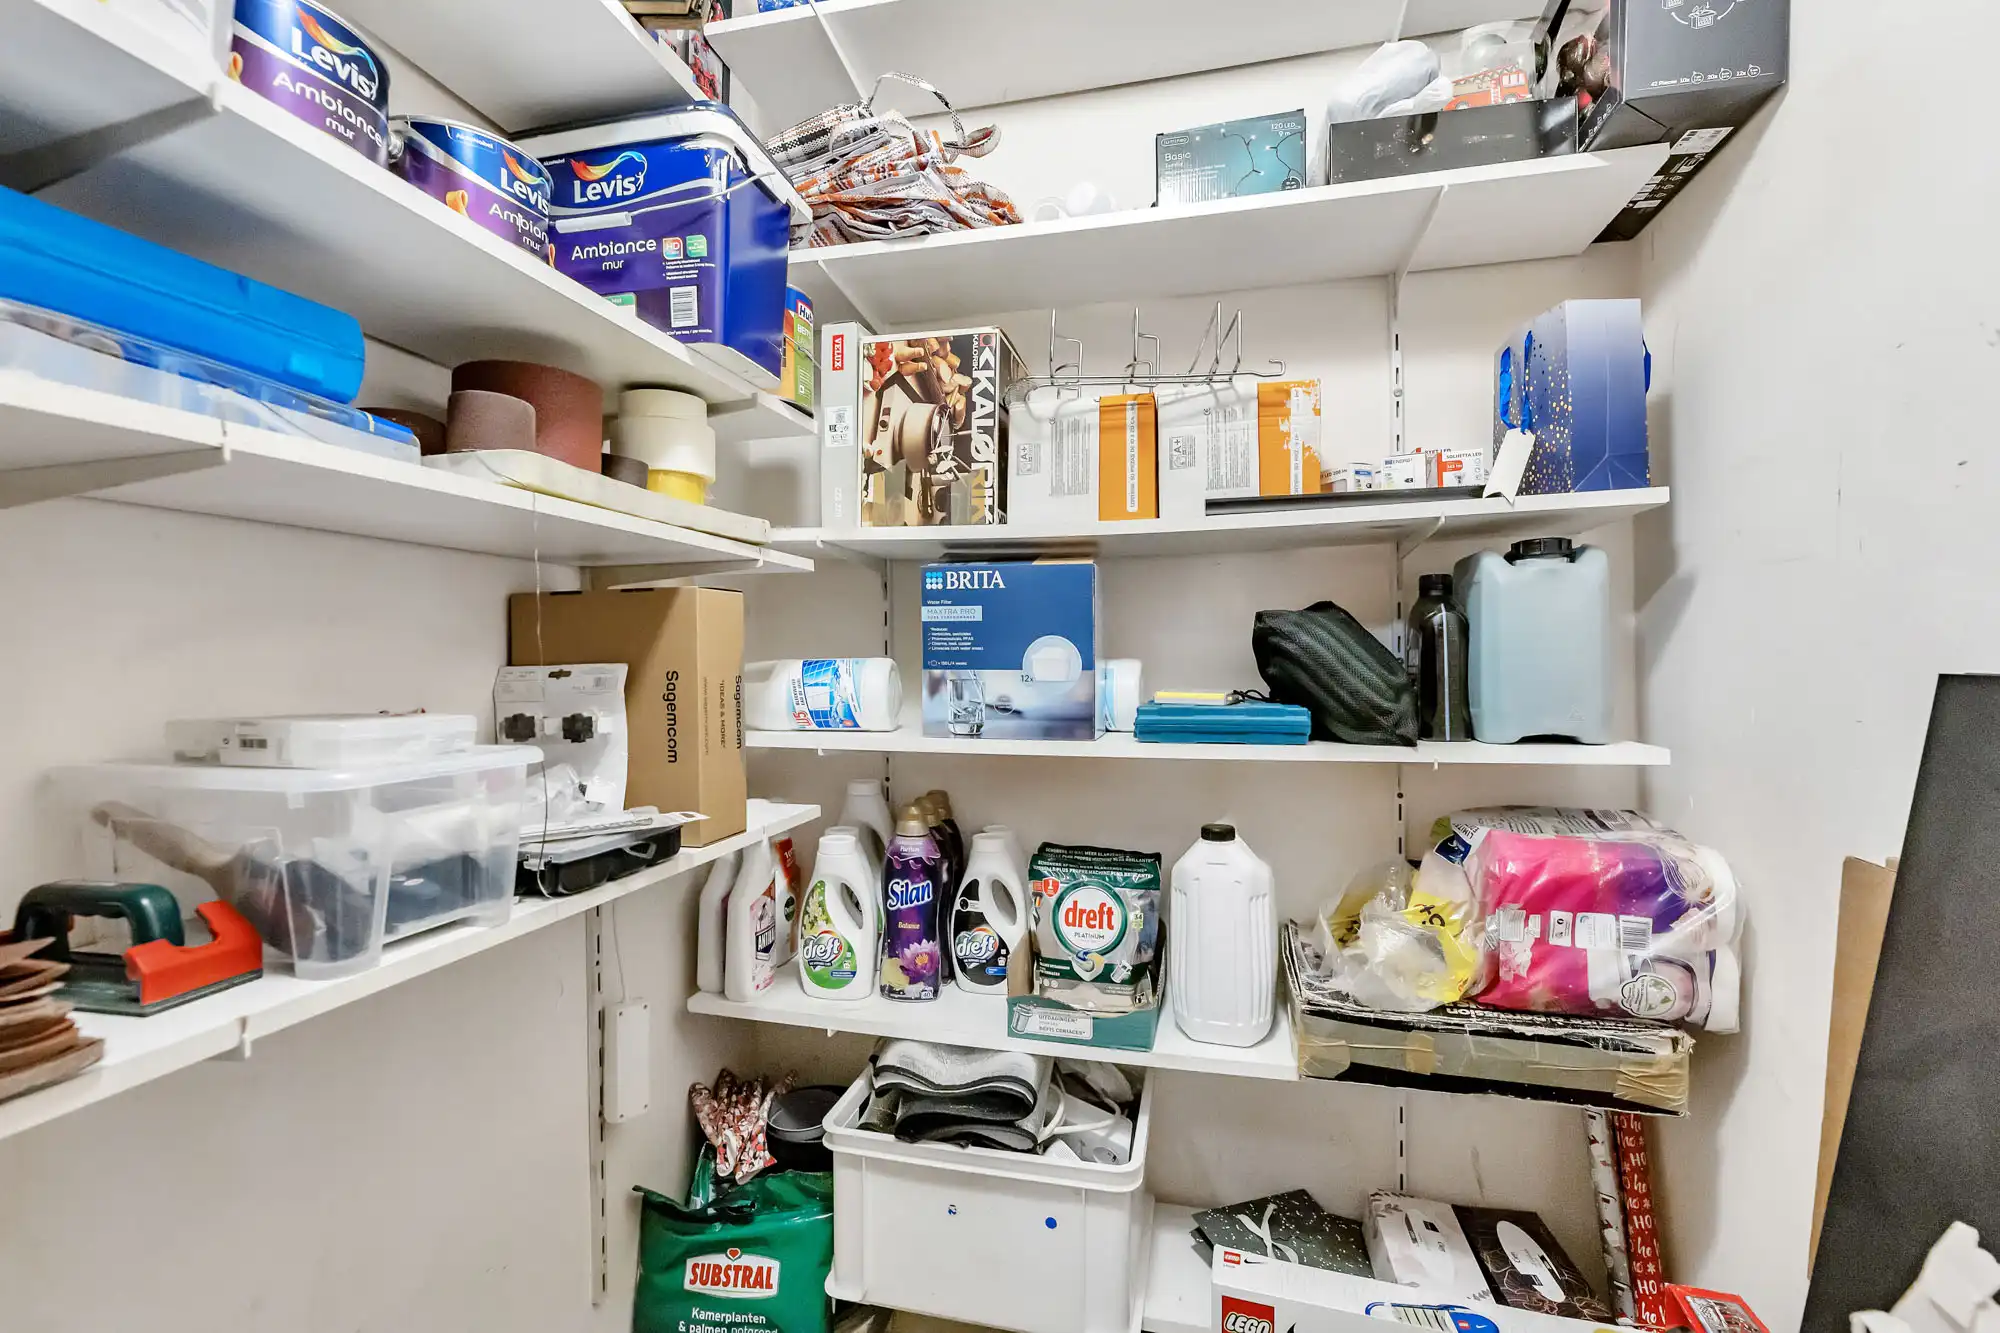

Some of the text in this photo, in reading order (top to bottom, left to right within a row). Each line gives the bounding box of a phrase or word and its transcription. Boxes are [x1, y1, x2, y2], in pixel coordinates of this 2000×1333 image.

[292, 26, 373, 98] Levis
[272, 72, 385, 147] Ambiance
[325, 117, 355, 140] mur
[1165, 152, 1191, 161] Basic
[501, 167, 548, 215] Levis
[573, 175, 636, 203] Levis
[523, 236, 541, 251] mur
[571, 239, 657, 261] Ambiance
[666, 242, 681, 250] HD
[602, 260, 624, 271] mur
[834, 337, 843, 368] VELUX
[945, 570, 1006, 589] BRITA
[1020, 674, 1034, 683] 12x
[663, 670, 679, 763] Sagemcom
[733, 675, 742, 749] Sagemcom
[887, 879, 932, 910] Silan
[1047, 879, 1053, 889] 1
[1064, 900, 1114, 930] dreft
[956, 934, 995, 958] dreft
[1074, 931, 1105, 940] PLATINUM
[803, 936, 840, 960] dreft
[1633, 1214, 1653, 1230] HO
[1638, 1236, 1652, 1258] ho
[689, 1262, 773, 1290] SUBSTRAL
[1637, 1279, 1658, 1296] HO
[691, 1307, 766, 1324] Kamerplanten
[1225, 1313, 1271, 1333] LEGO
[1642, 1301, 1657, 1325] ho
[678, 1321, 686, 1332] &
[690, 1323, 727, 1333] palmen
